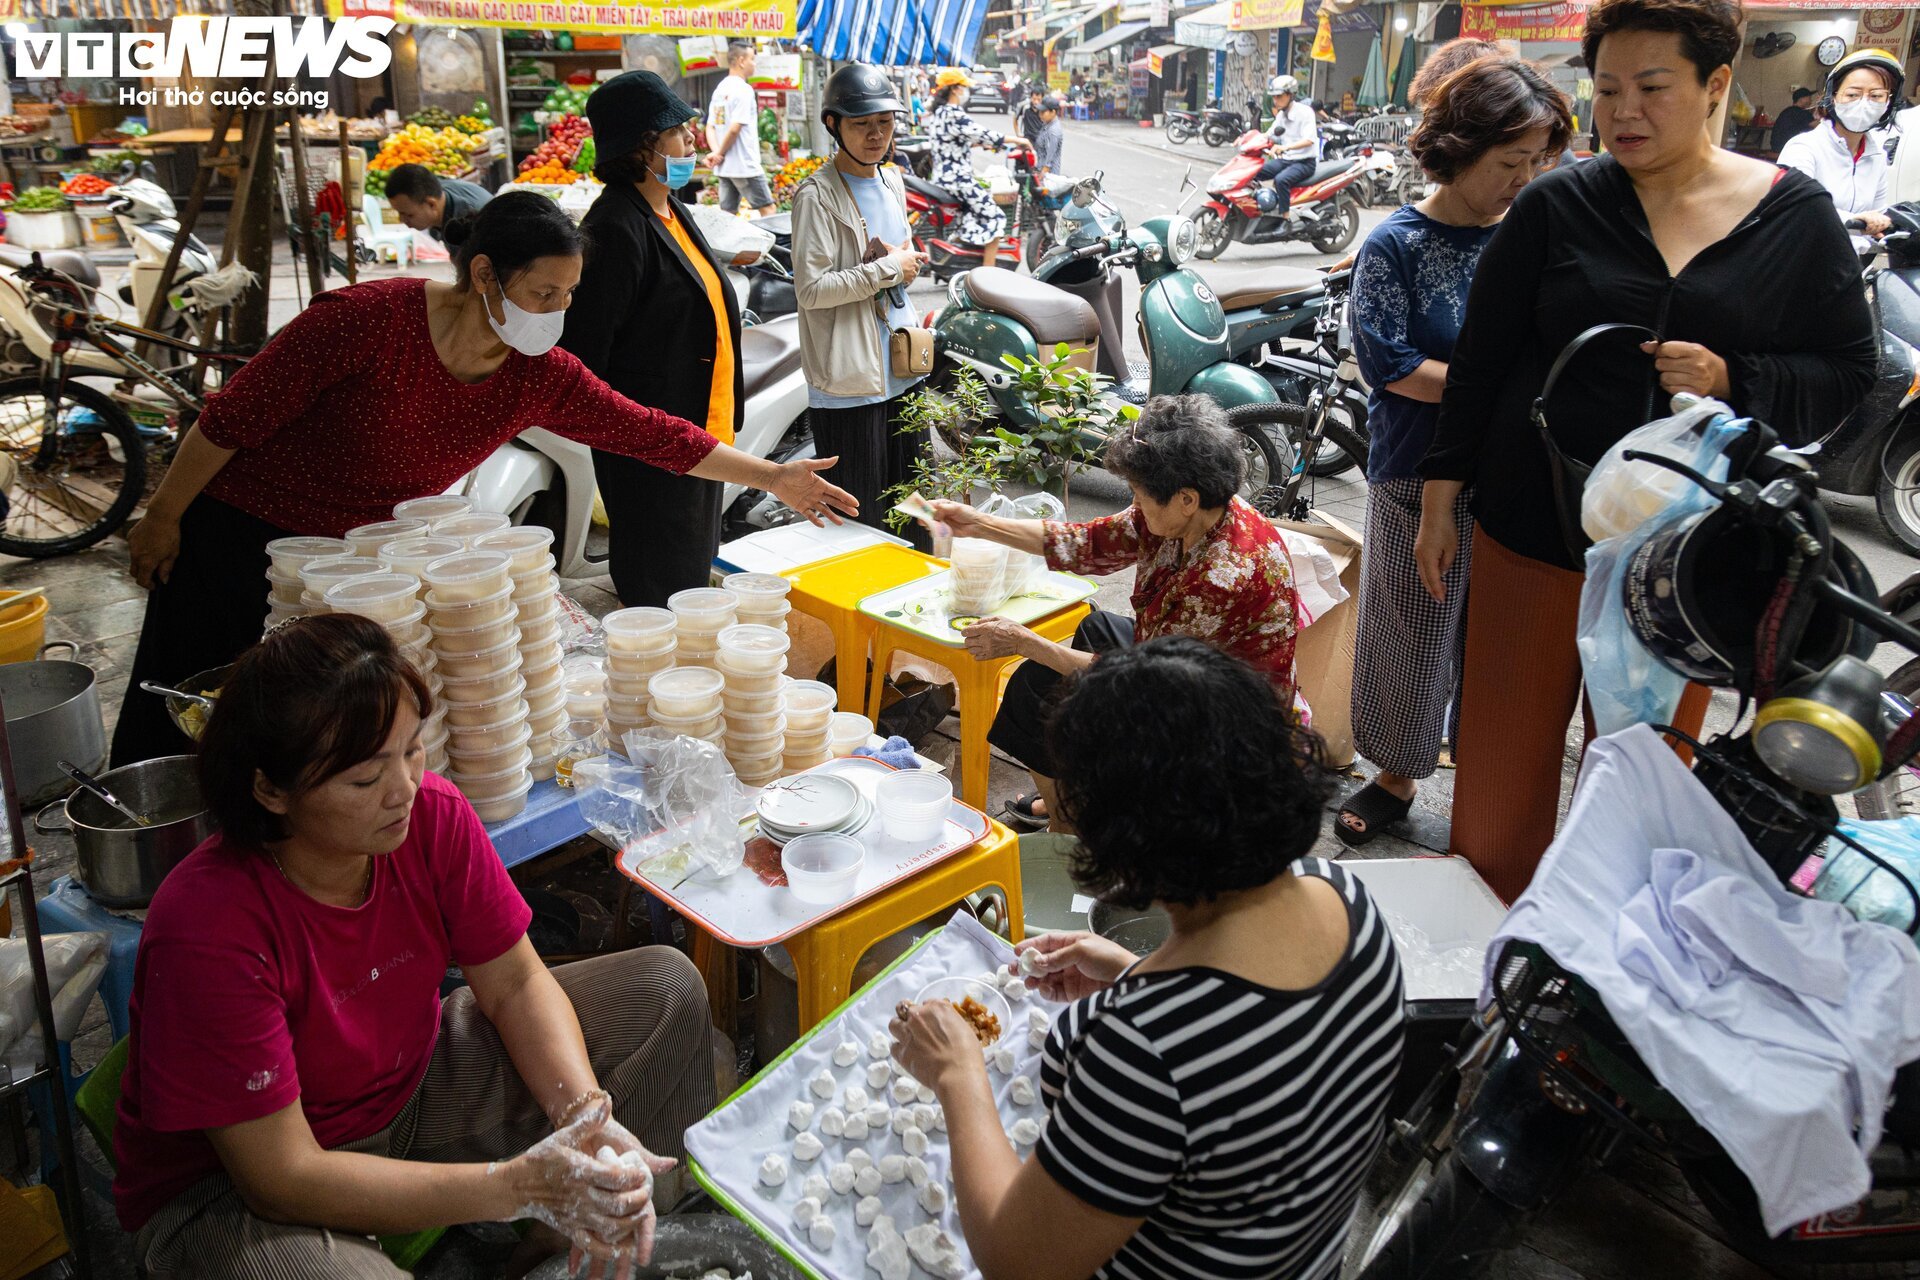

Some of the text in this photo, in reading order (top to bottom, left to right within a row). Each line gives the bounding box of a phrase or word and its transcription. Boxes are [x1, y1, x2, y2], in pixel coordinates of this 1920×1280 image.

[630, 4, 649, 26] TÂY
[662, 5, 688, 27] TRÁI
[691, 6, 713, 28] CÂY
[717, 7, 749, 33] NHẬP
[752, 4, 783, 31] KHẨU
[1858, 35, 1871, 45] 14
